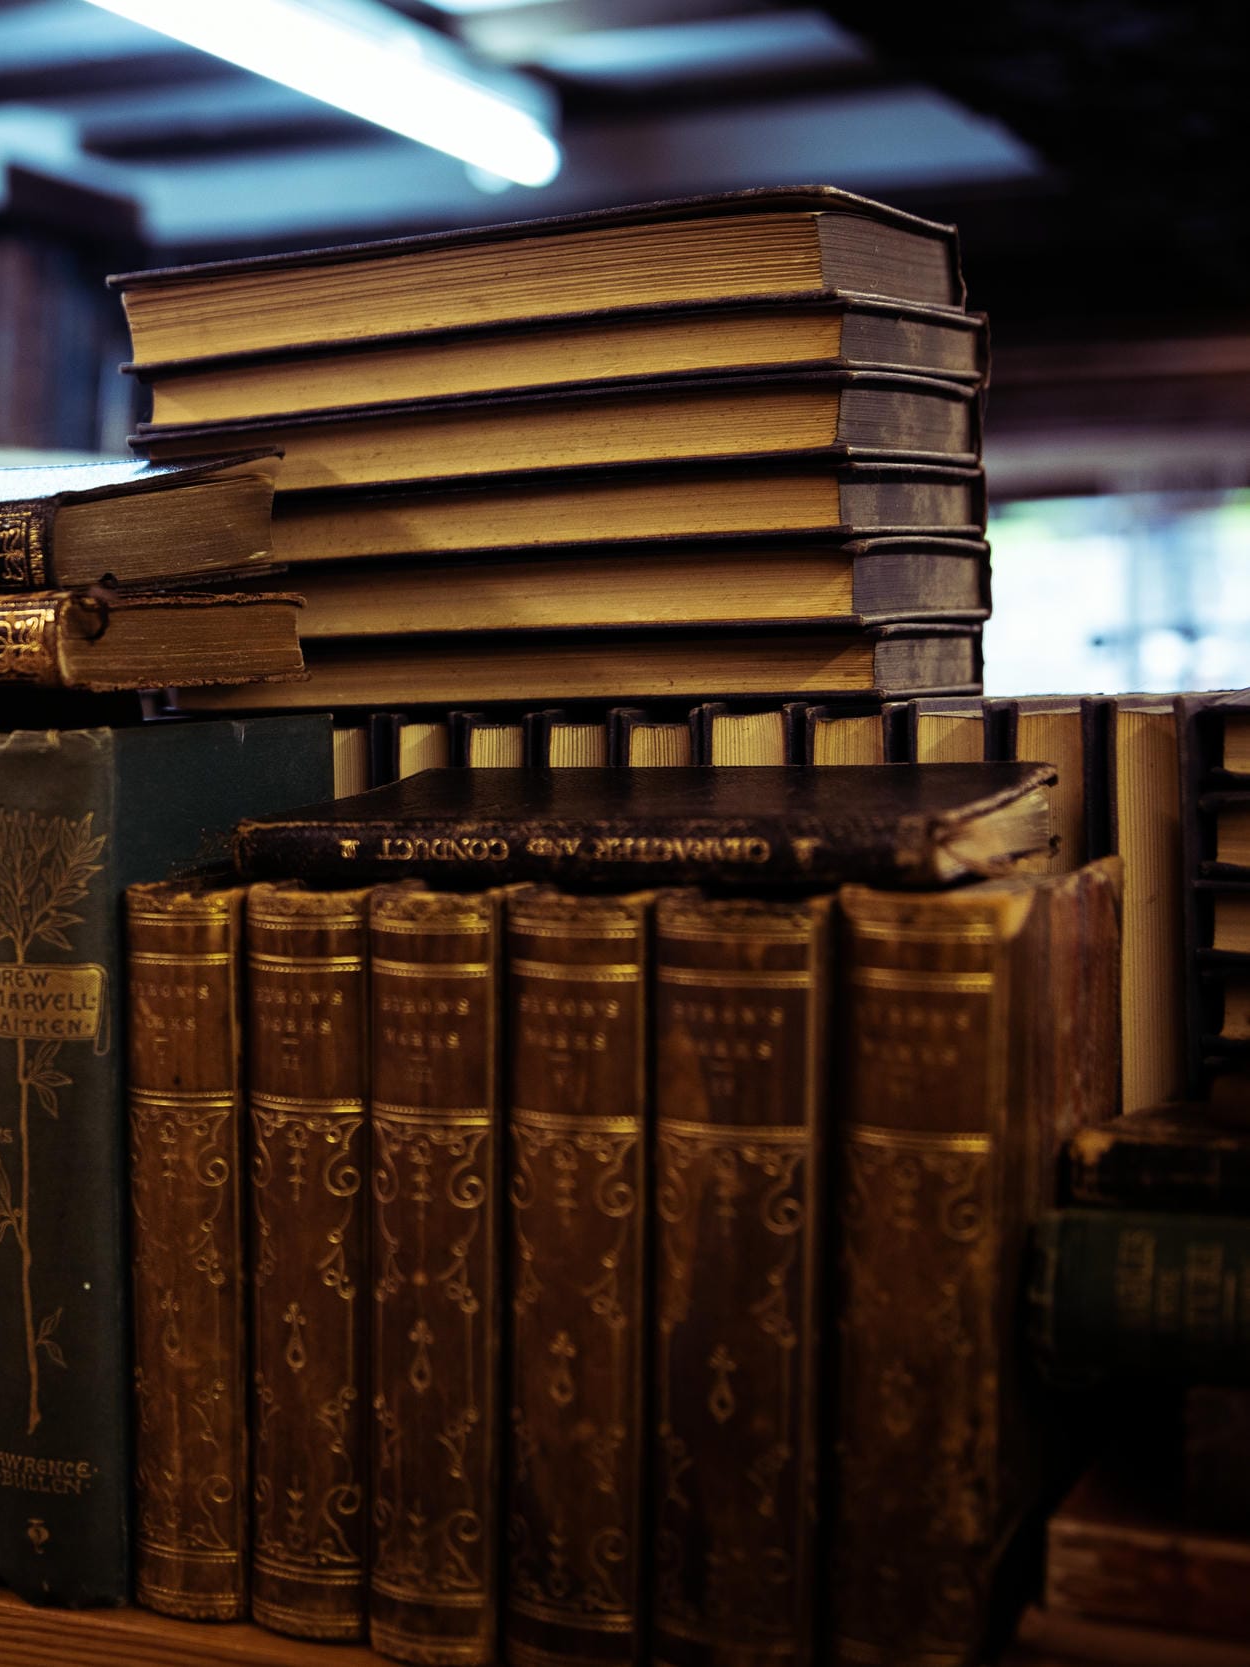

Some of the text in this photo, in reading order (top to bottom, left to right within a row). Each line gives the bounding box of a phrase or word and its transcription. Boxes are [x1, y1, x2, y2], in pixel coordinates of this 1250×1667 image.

[376, 836, 771, 864] CHARACTER AND CONDUCT
